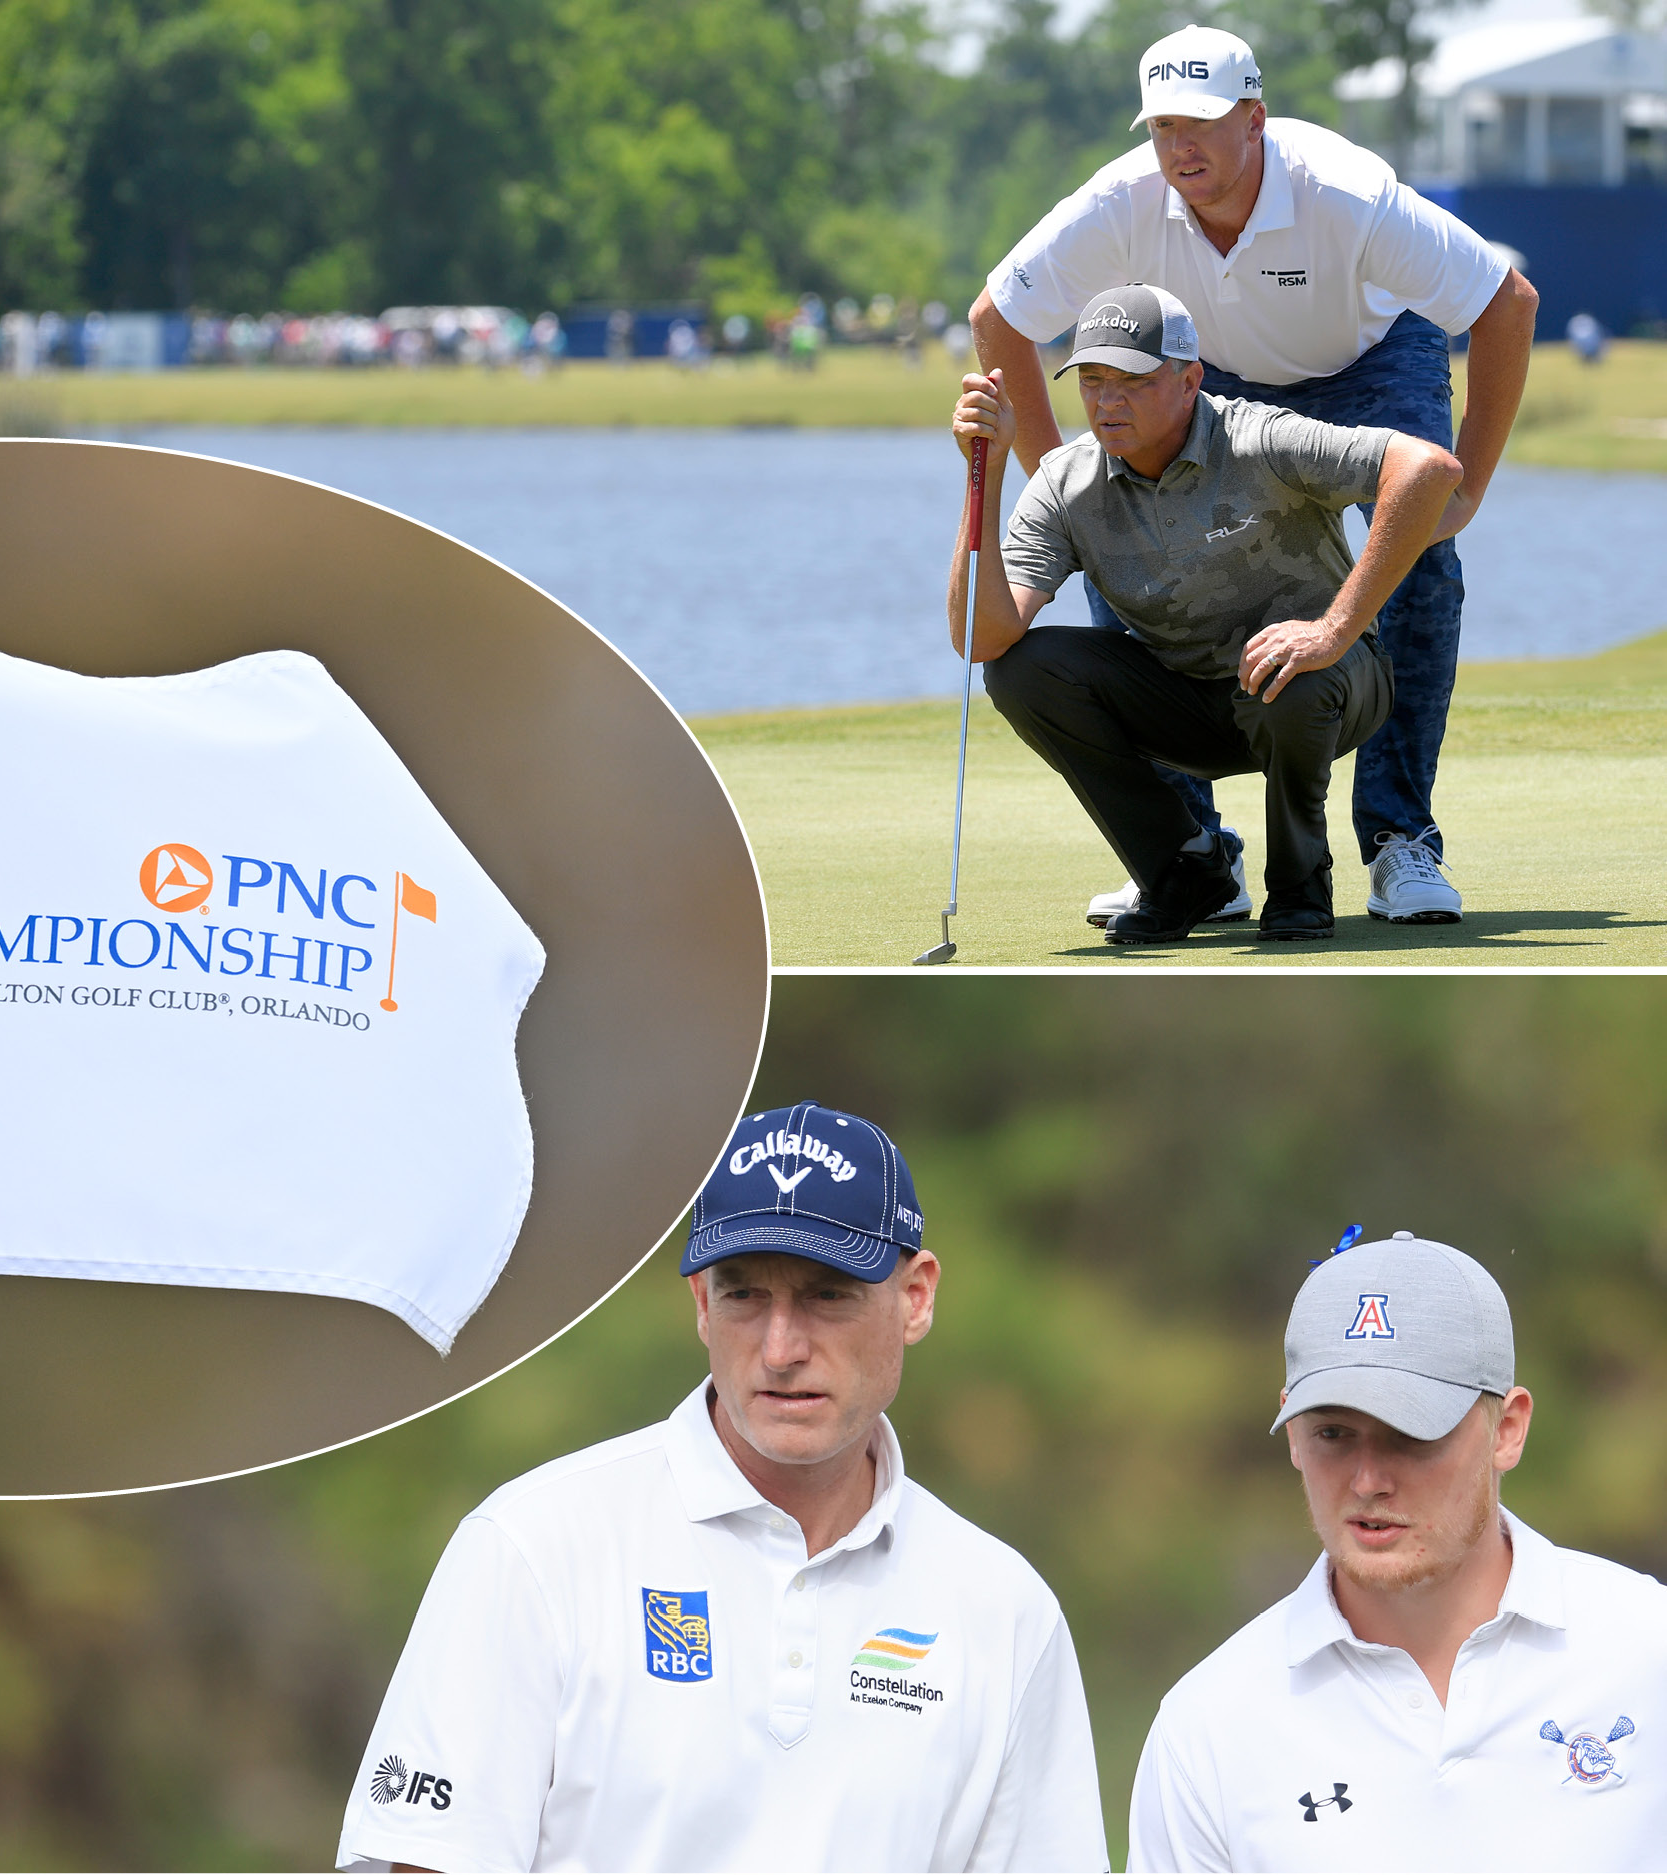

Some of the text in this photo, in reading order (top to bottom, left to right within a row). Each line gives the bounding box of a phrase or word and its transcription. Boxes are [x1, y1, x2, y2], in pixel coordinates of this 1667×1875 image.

[1147, 60, 1210, 87] PING
[1277, 276, 1307, 287] RSM
[1205, 513, 1261, 544] RLX
[221, 854, 378, 930] PNC
[71, 985, 143, 1008] GOLF
[240, 995, 371, 1032] ORLANDO
[729, 1128, 858, 1183] Callaway
[1344, 1292, 1397, 1341] A
[650, 1649, 709, 1677] RBC
[849, 1669, 944, 1702] Constellation
[849, 1691, 923, 1716] An Exelon Company
[405, 1770, 453, 1811] IFS
